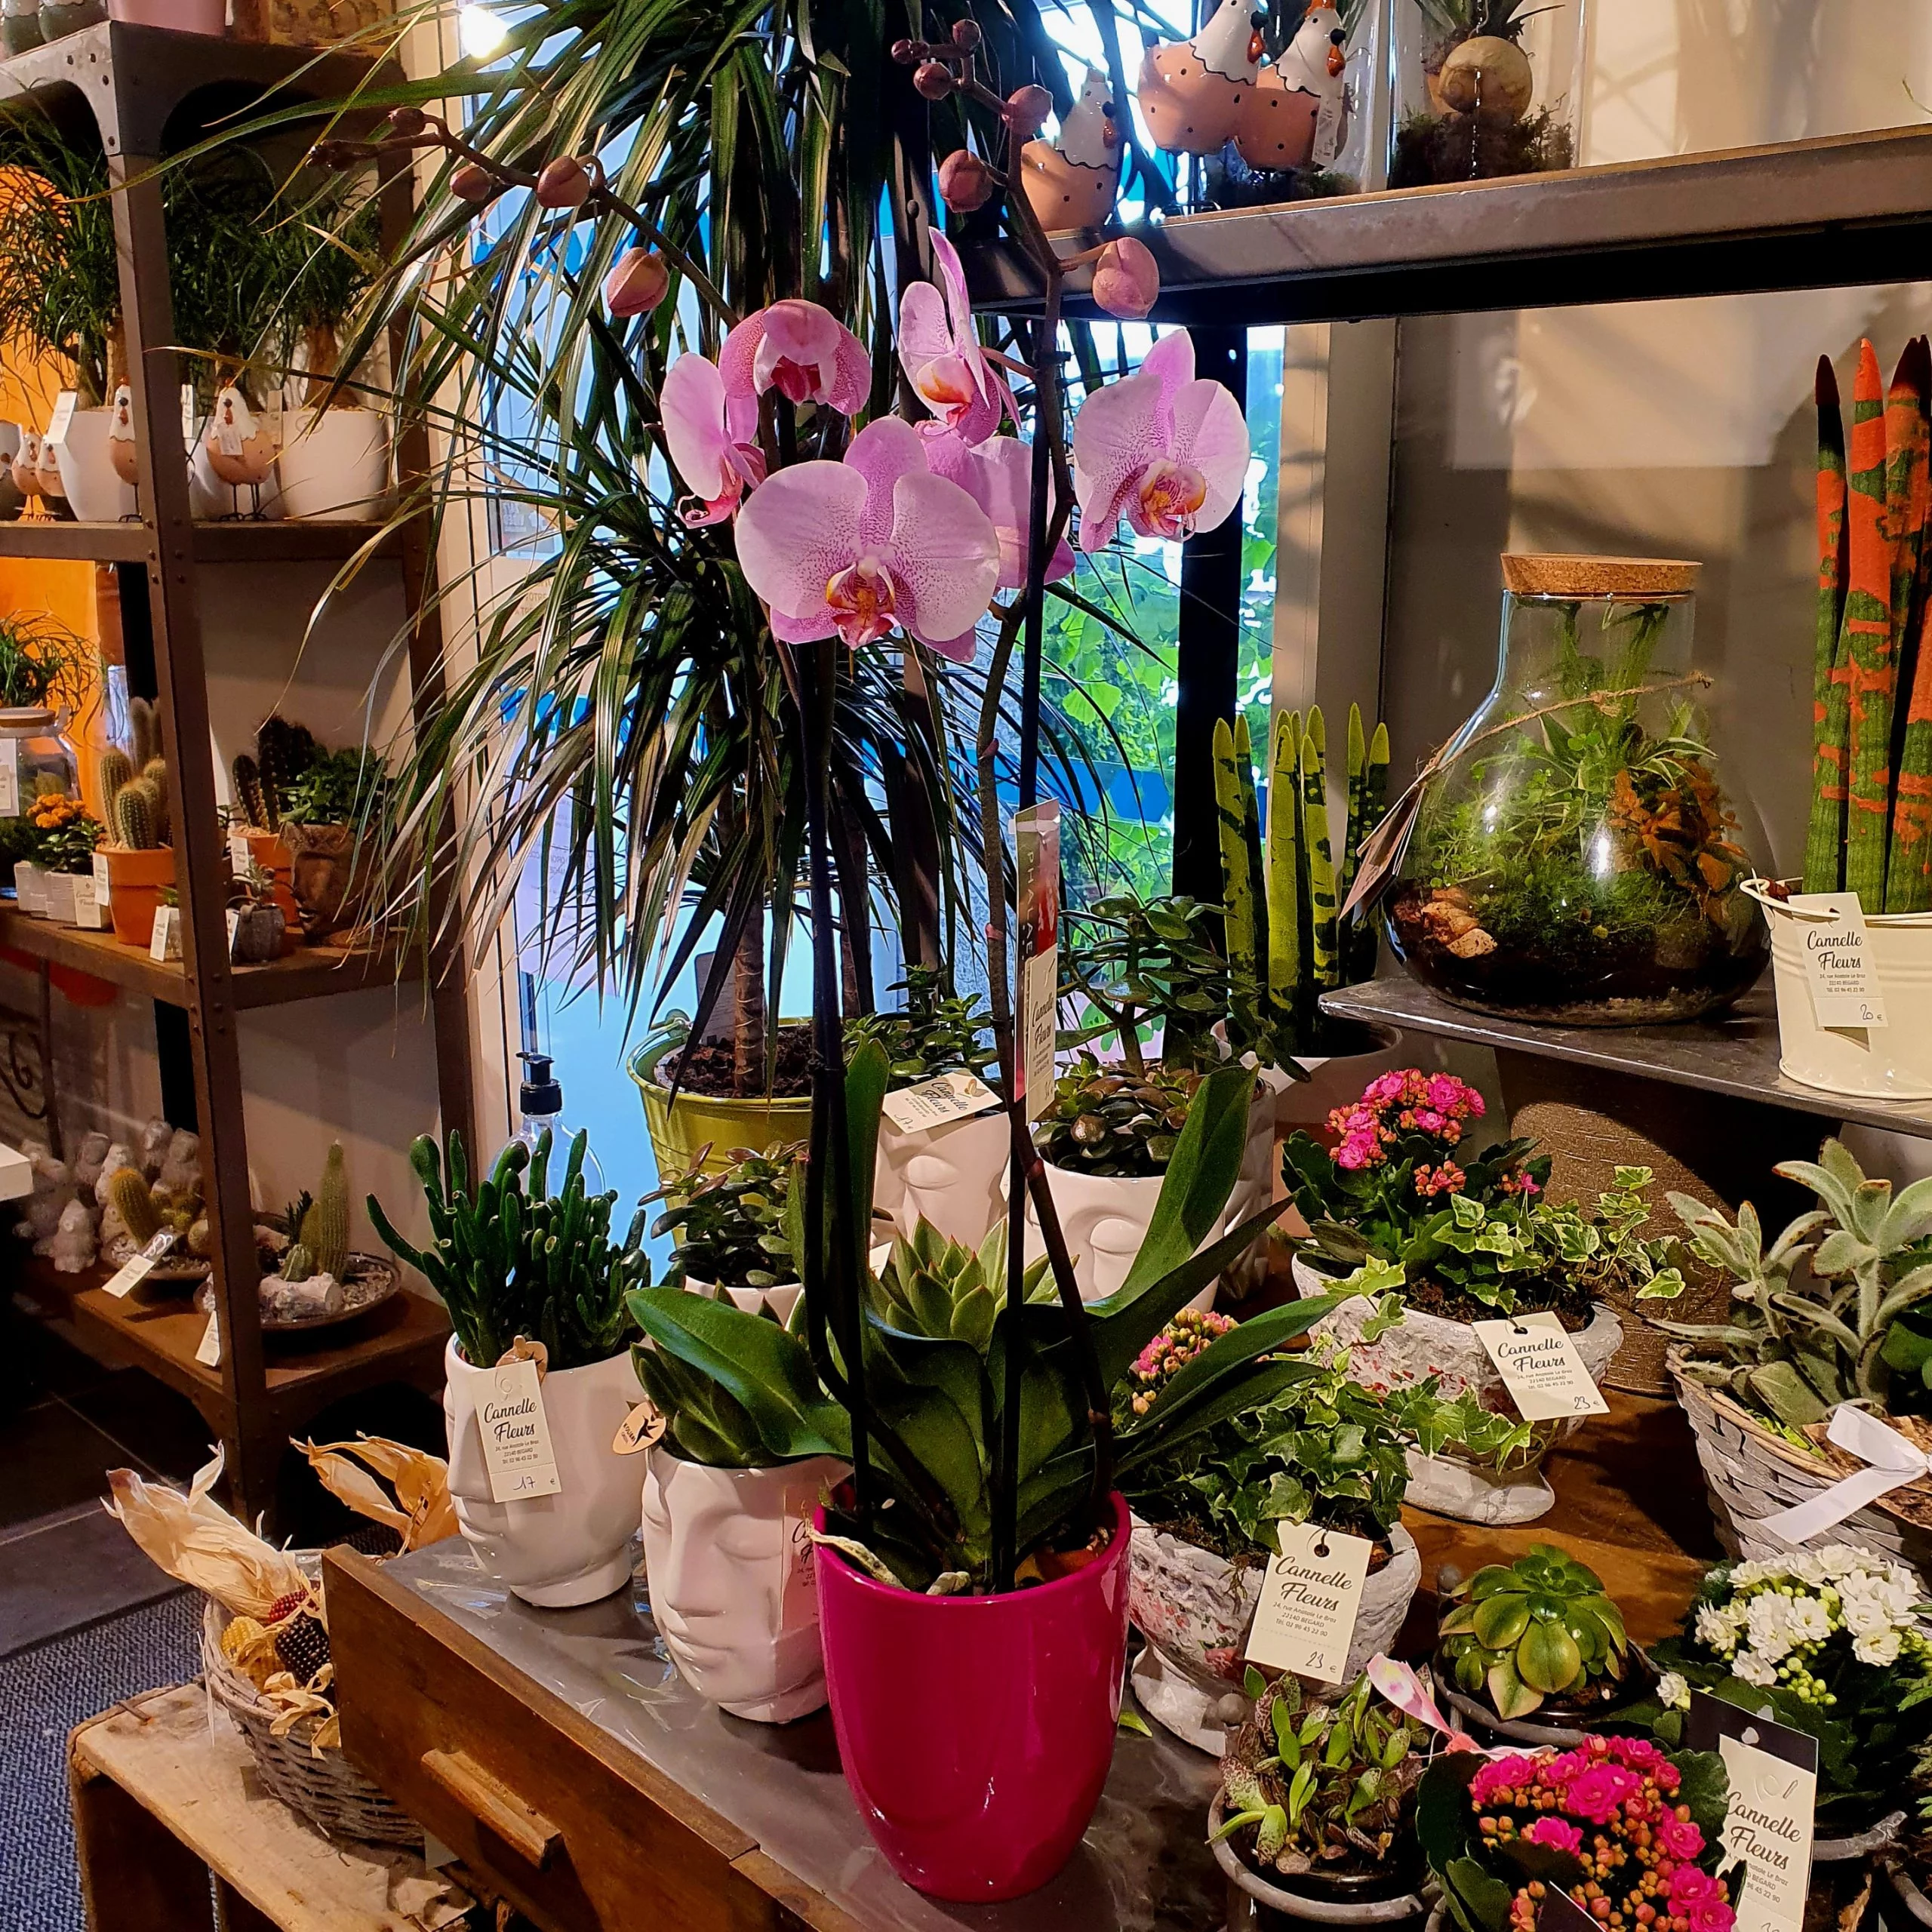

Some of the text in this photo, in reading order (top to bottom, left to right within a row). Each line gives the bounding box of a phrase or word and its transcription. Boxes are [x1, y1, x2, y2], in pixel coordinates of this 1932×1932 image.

[1807, 930, 1863, 950] Cannelle
[1817, 951, 1862, 971] Fleurs
[1860, 1003, 1874, 1020] 20
[921, 1090, 950, 1112] Fleurs
[931, 1081, 969, 1111] Cannelle
[1497, 1338, 1564, 1358] Cannelle
[1512, 1355, 1566, 1372] Fleurs
[484, 1398, 537, 1423] Cannelle
[1574, 1396, 1591, 1410] 23
[494, 1421, 535, 1442] Fleurs
[512, 1475, 536, 1491] 17
[1275, 1556, 1353, 1590] Cannelle
[1281, 1582, 1340, 1611] Fleurs
[1305, 1651, 1324, 1669] 23
[1726, 1791, 1801, 1843] Cannelle
[1730, 1825, 1790, 1870] Fleurs
[1748, 1863, 1766, 1875] natole
